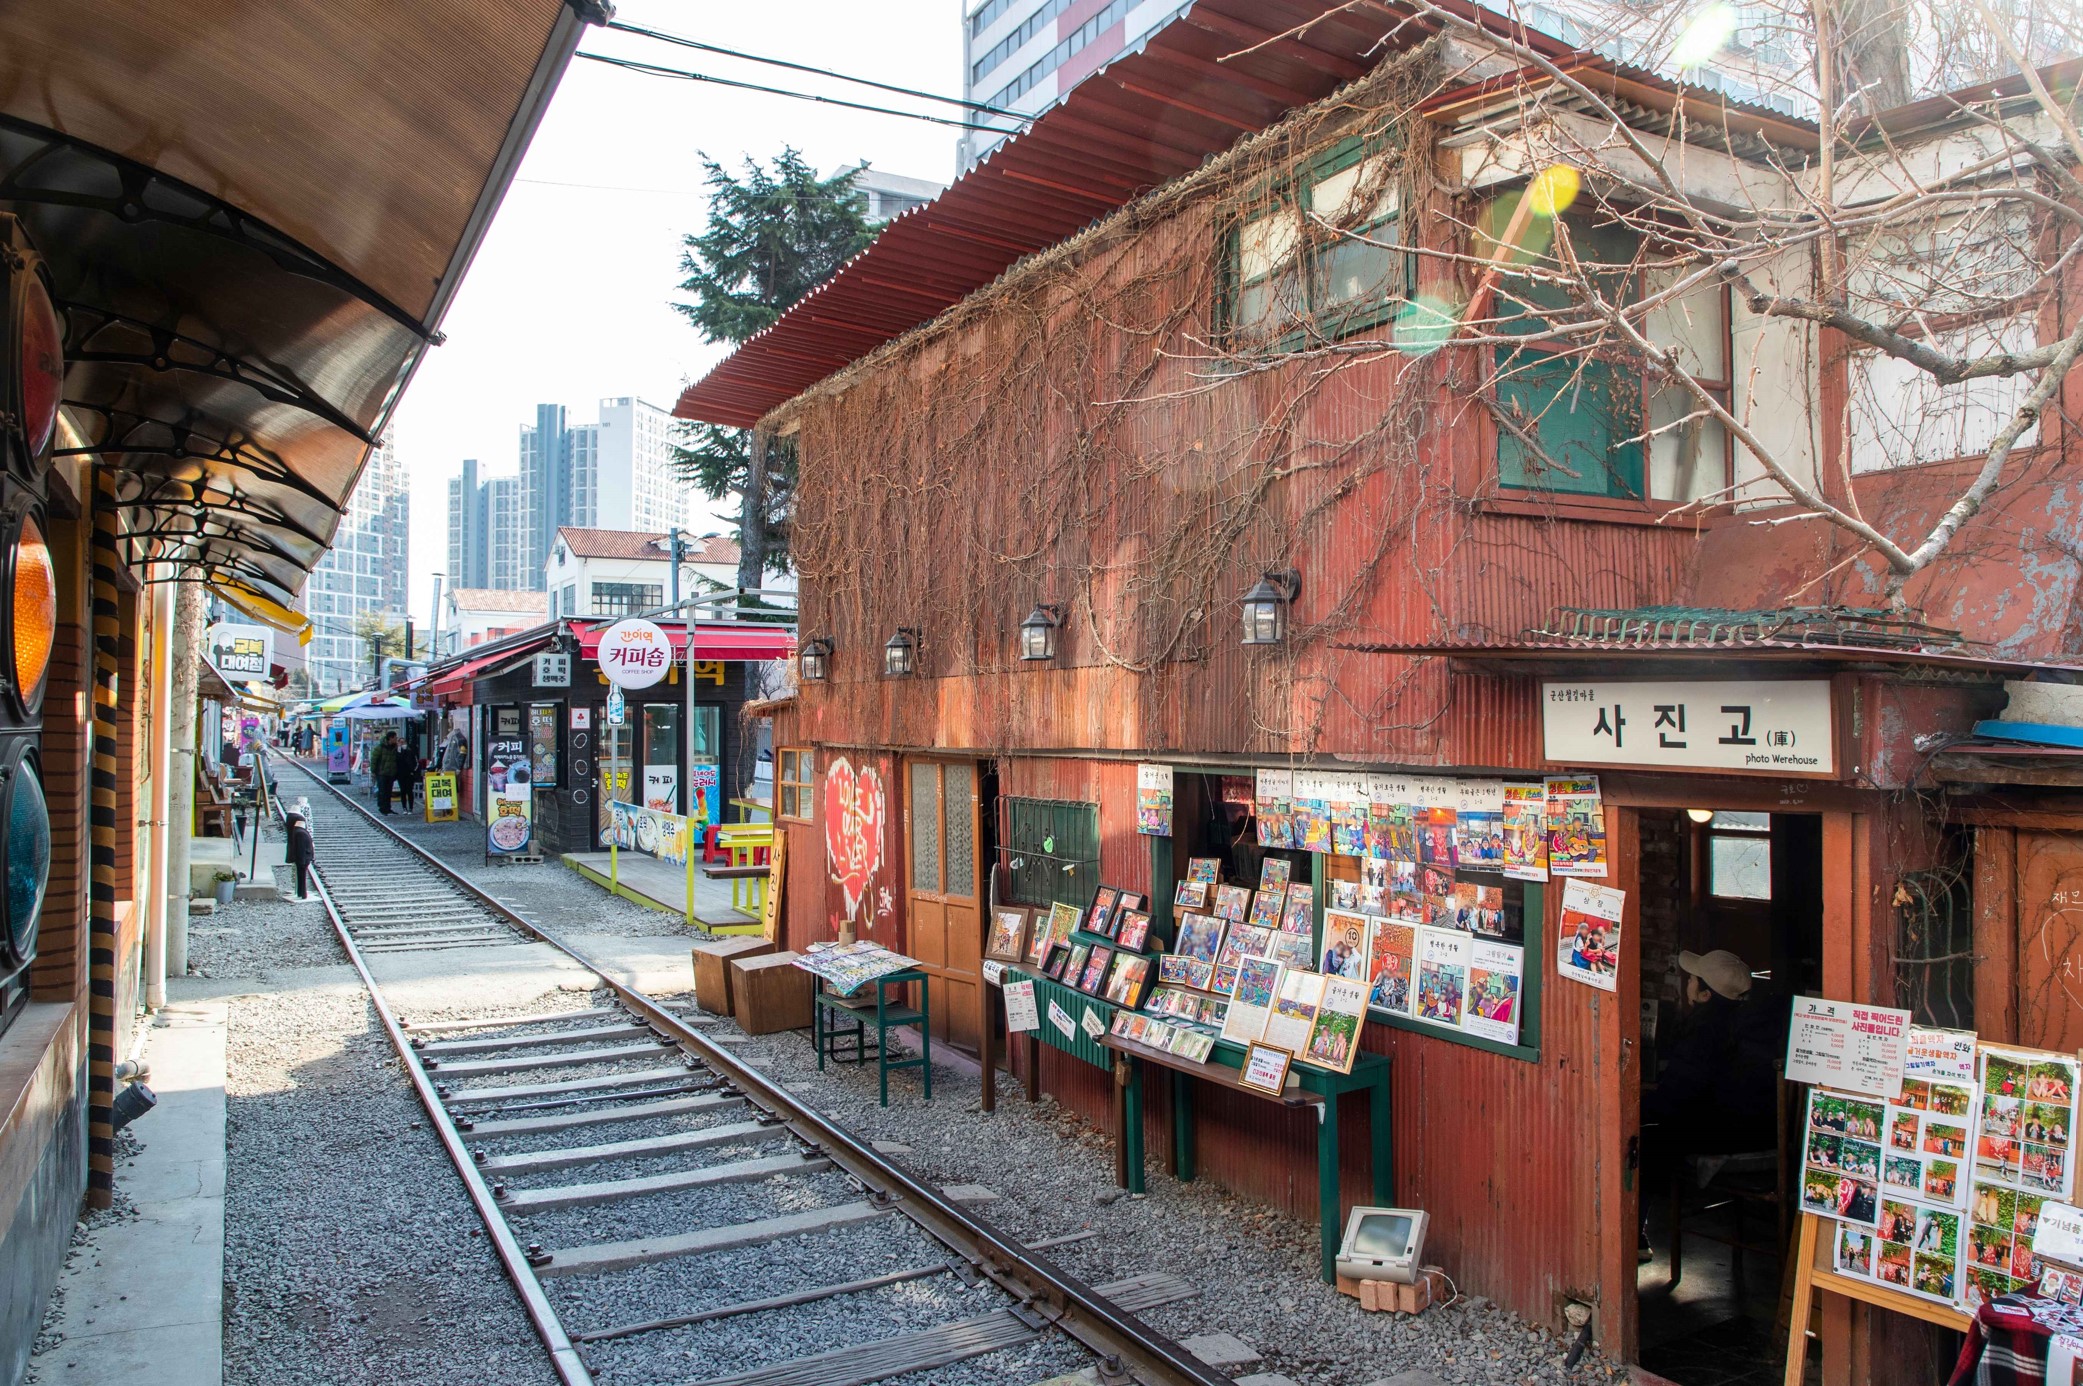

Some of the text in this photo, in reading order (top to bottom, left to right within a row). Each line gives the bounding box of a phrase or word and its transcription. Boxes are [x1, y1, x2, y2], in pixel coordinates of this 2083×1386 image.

[620, 630, 653, 644] 간이역
[234, 637, 265, 656] 교복
[542, 657, 566, 666] 커피
[609, 647, 664, 668] 커피숍
[219, 655, 264, 673] 대여점
[542, 675, 567, 683] 생맥주
[1550, 688, 1595, 702] 군산철길마을
[498, 741, 523, 753] 커피
[1745, 753, 1818, 766] photo Werehouse
[431, 779, 452, 789] 교복
[648, 775, 673, 784] 커피
[431, 789, 452, 798] 대여
[1348, 931, 1357, 941] 10
[1853, 1010, 1869, 1021] 직접
[1870, 1012, 1903, 1026] 찍어드린
[1851, 1021, 1900, 1037] 사진들입니다
[1954, 1041, 1971, 1053] 인화
